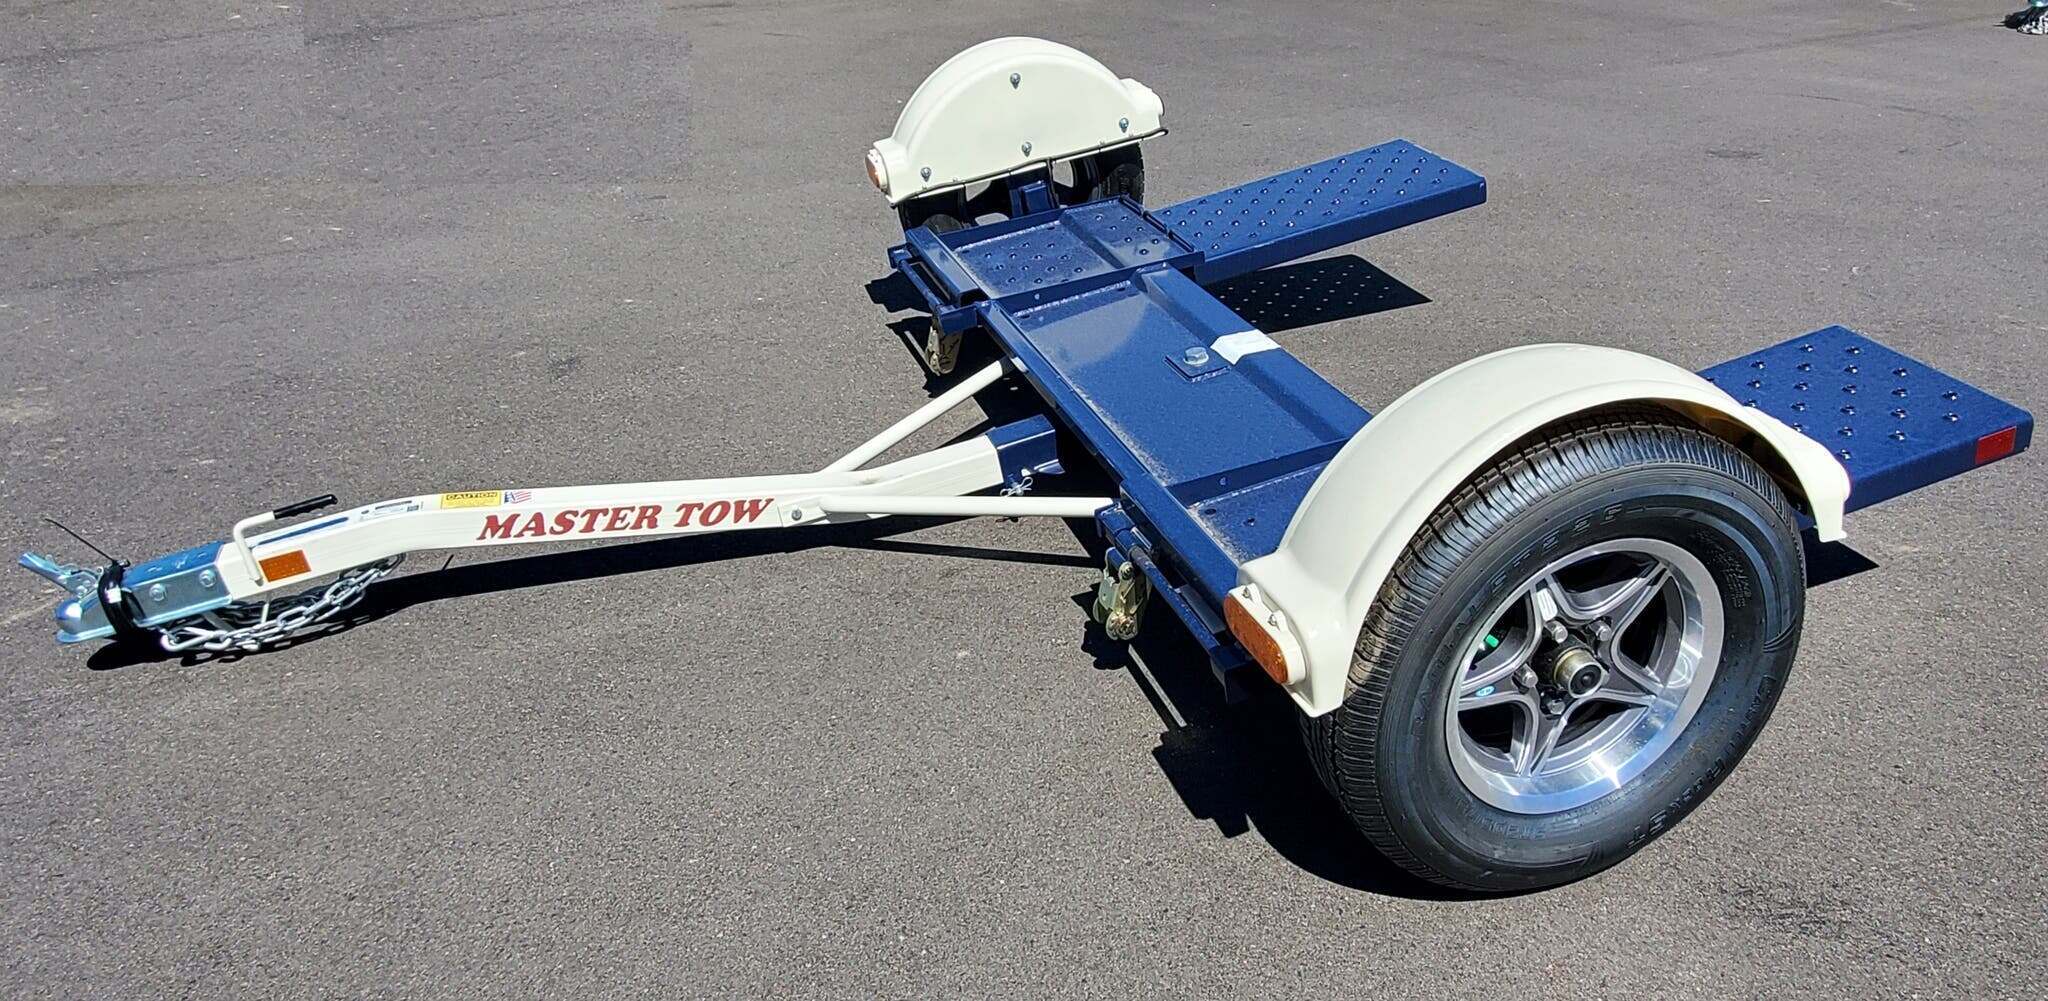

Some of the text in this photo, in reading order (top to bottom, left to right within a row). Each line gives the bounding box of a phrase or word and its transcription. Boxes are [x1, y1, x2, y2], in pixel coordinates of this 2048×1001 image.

[446, 491, 498, 501] CAUTION
[476, 497, 775, 541] MASTER TOW
